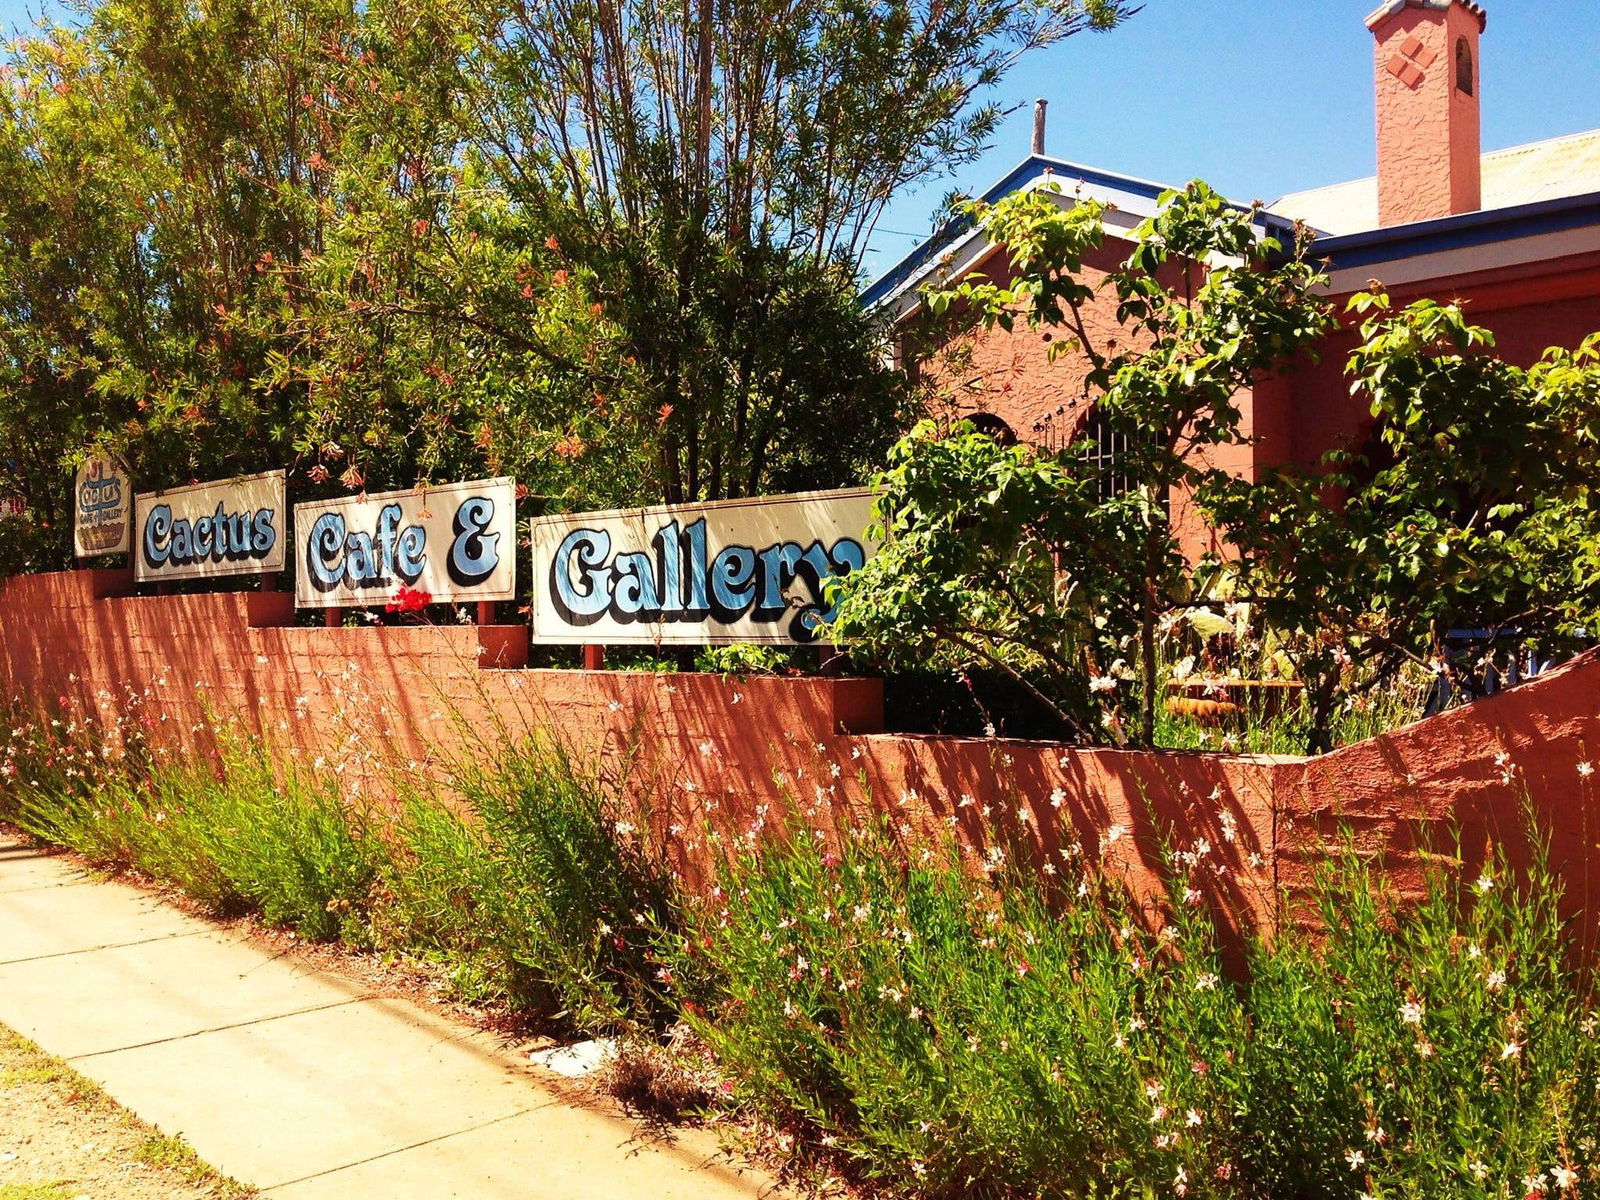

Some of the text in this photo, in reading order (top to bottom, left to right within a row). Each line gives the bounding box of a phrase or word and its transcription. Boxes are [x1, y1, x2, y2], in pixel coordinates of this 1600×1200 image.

[143, 501, 276, 567] Cactus
[307, 497, 500, 592] Cafe &
[549, 518, 866, 643] Gallery
